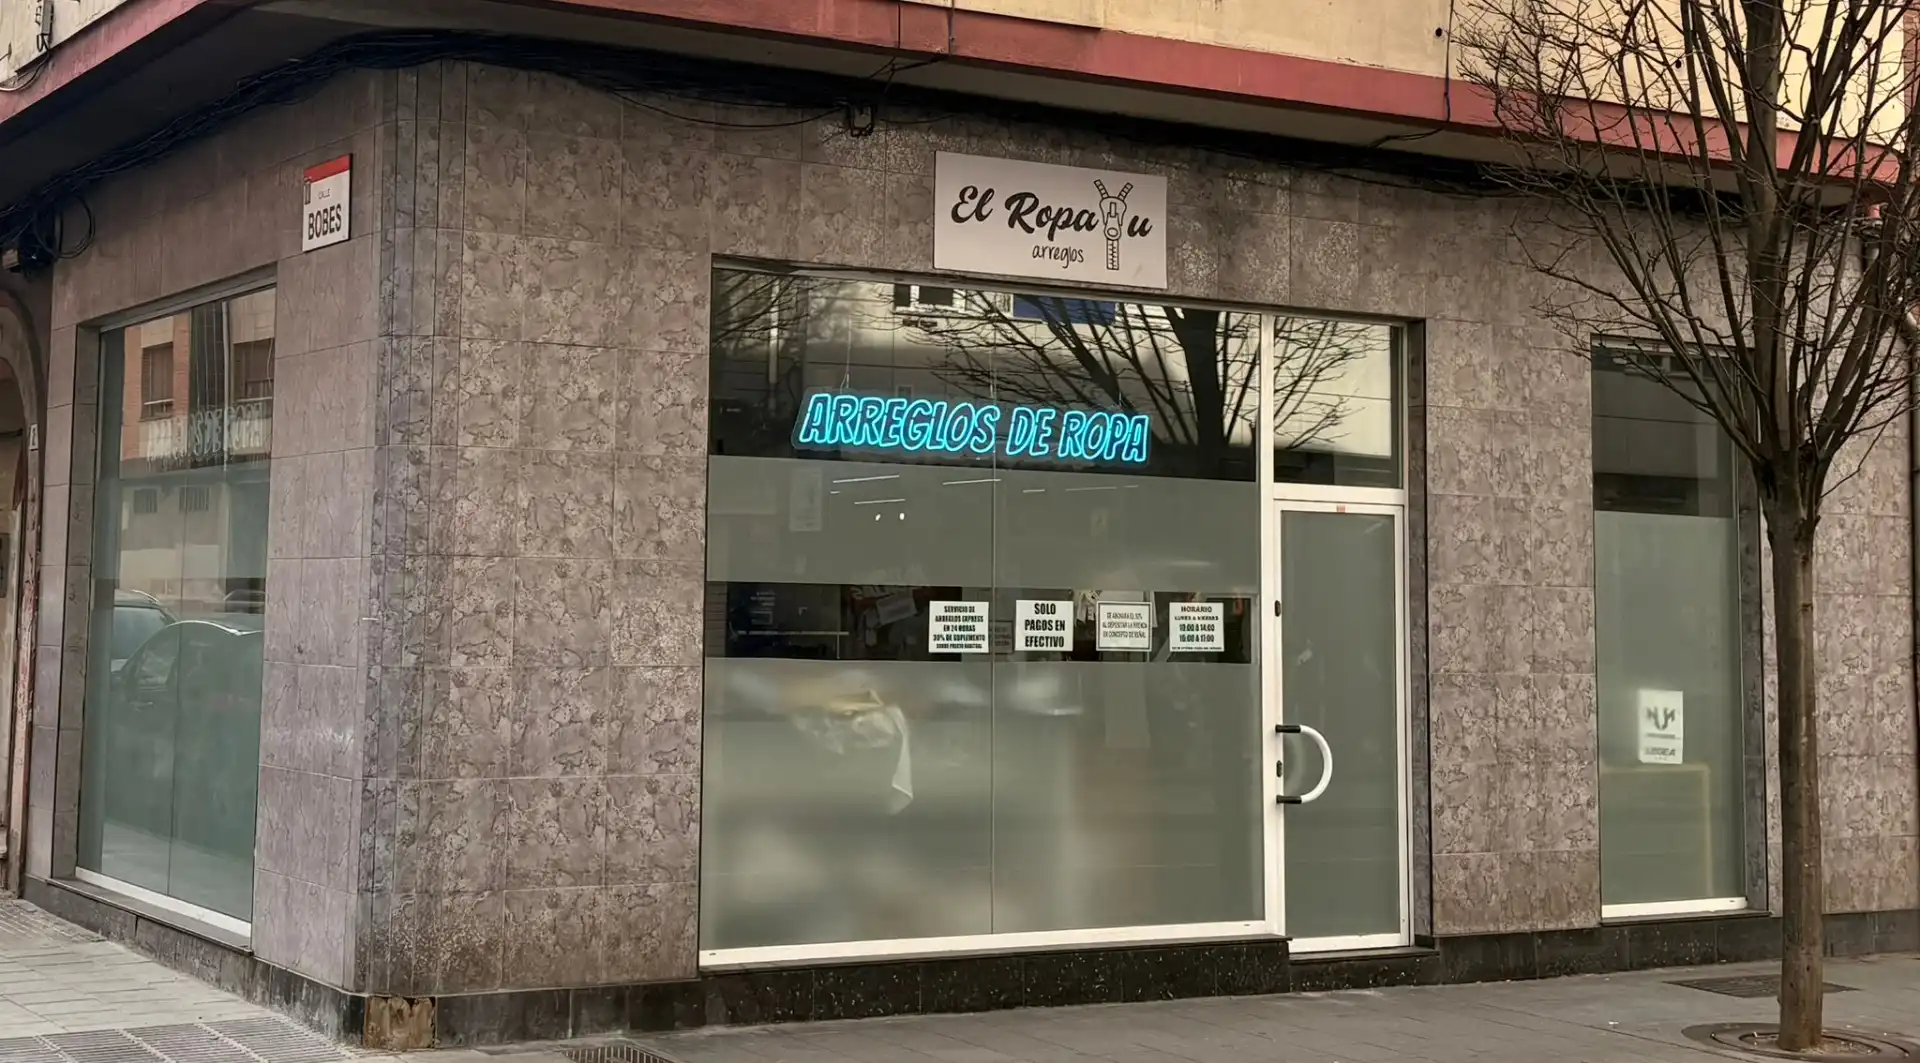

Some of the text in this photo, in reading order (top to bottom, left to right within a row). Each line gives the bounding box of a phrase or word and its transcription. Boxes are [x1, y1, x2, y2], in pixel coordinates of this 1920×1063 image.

[950, 184, 996, 225] El
[307, 202, 343, 241] BOBES
[1031, 243, 1085, 269] arreglos
[799, 393, 1150, 463] ARREGLOS DE ROPA
[1034, 602, 1057, 615] SOLO
[1180, 605, 1213, 613] HORARIO
[1024, 619, 1066, 631] PAGOS EN
[1024, 635, 1065, 648] EFECTIVO
